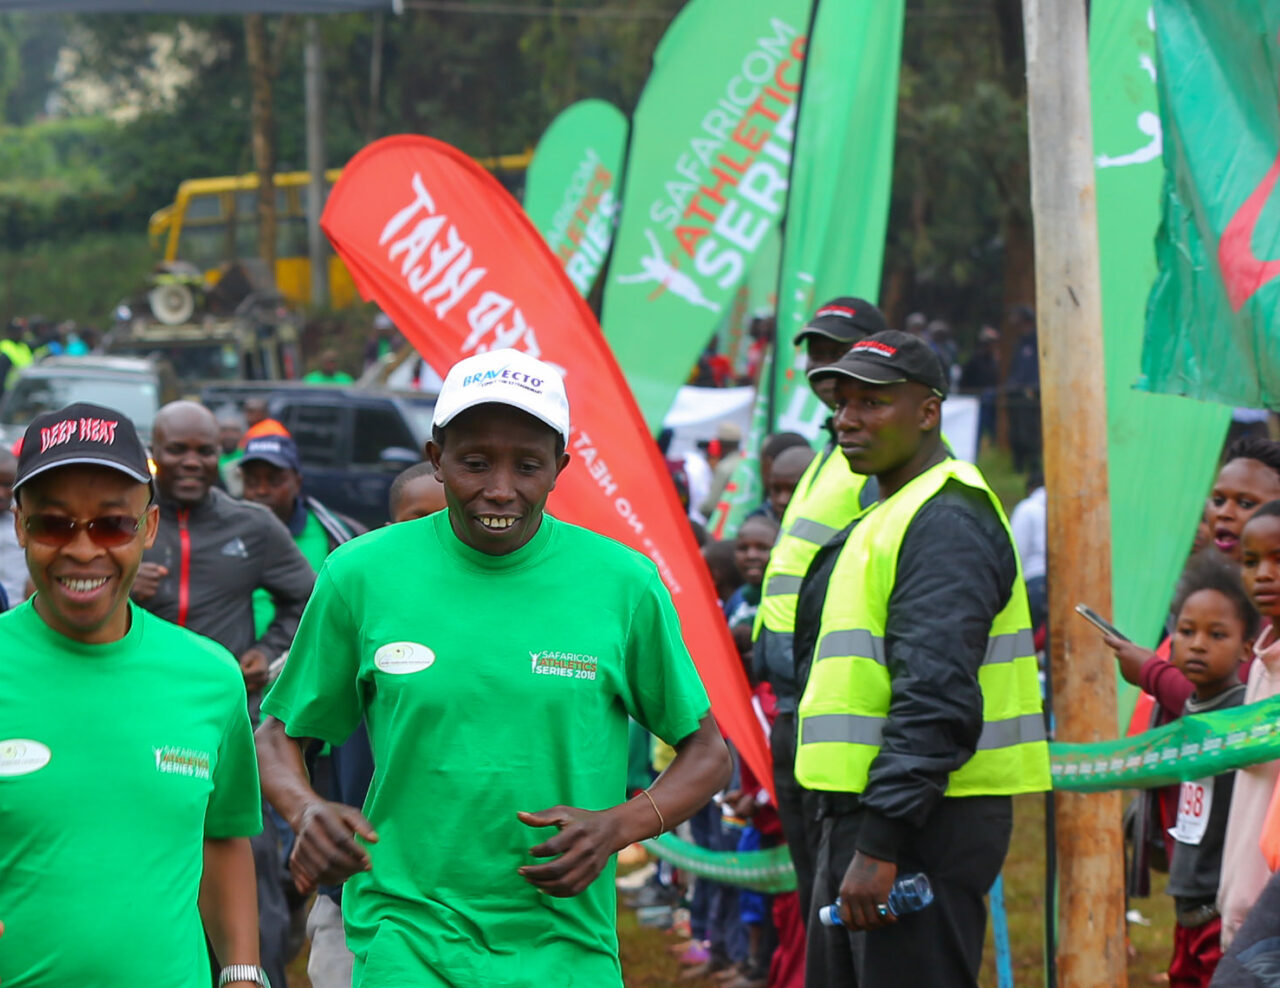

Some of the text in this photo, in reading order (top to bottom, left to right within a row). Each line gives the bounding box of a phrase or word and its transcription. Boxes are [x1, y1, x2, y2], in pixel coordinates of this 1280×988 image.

[649, 16, 797, 230] SAFARICOM
[463, 364, 543, 388] BRAVECTO
[40, 417, 118, 455] DEEP HEAT
[540, 658, 597, 672] ATHLETICS
[542, 650, 598, 664] SAFARICOM
[535, 666, 596, 681] SERIES 2018
